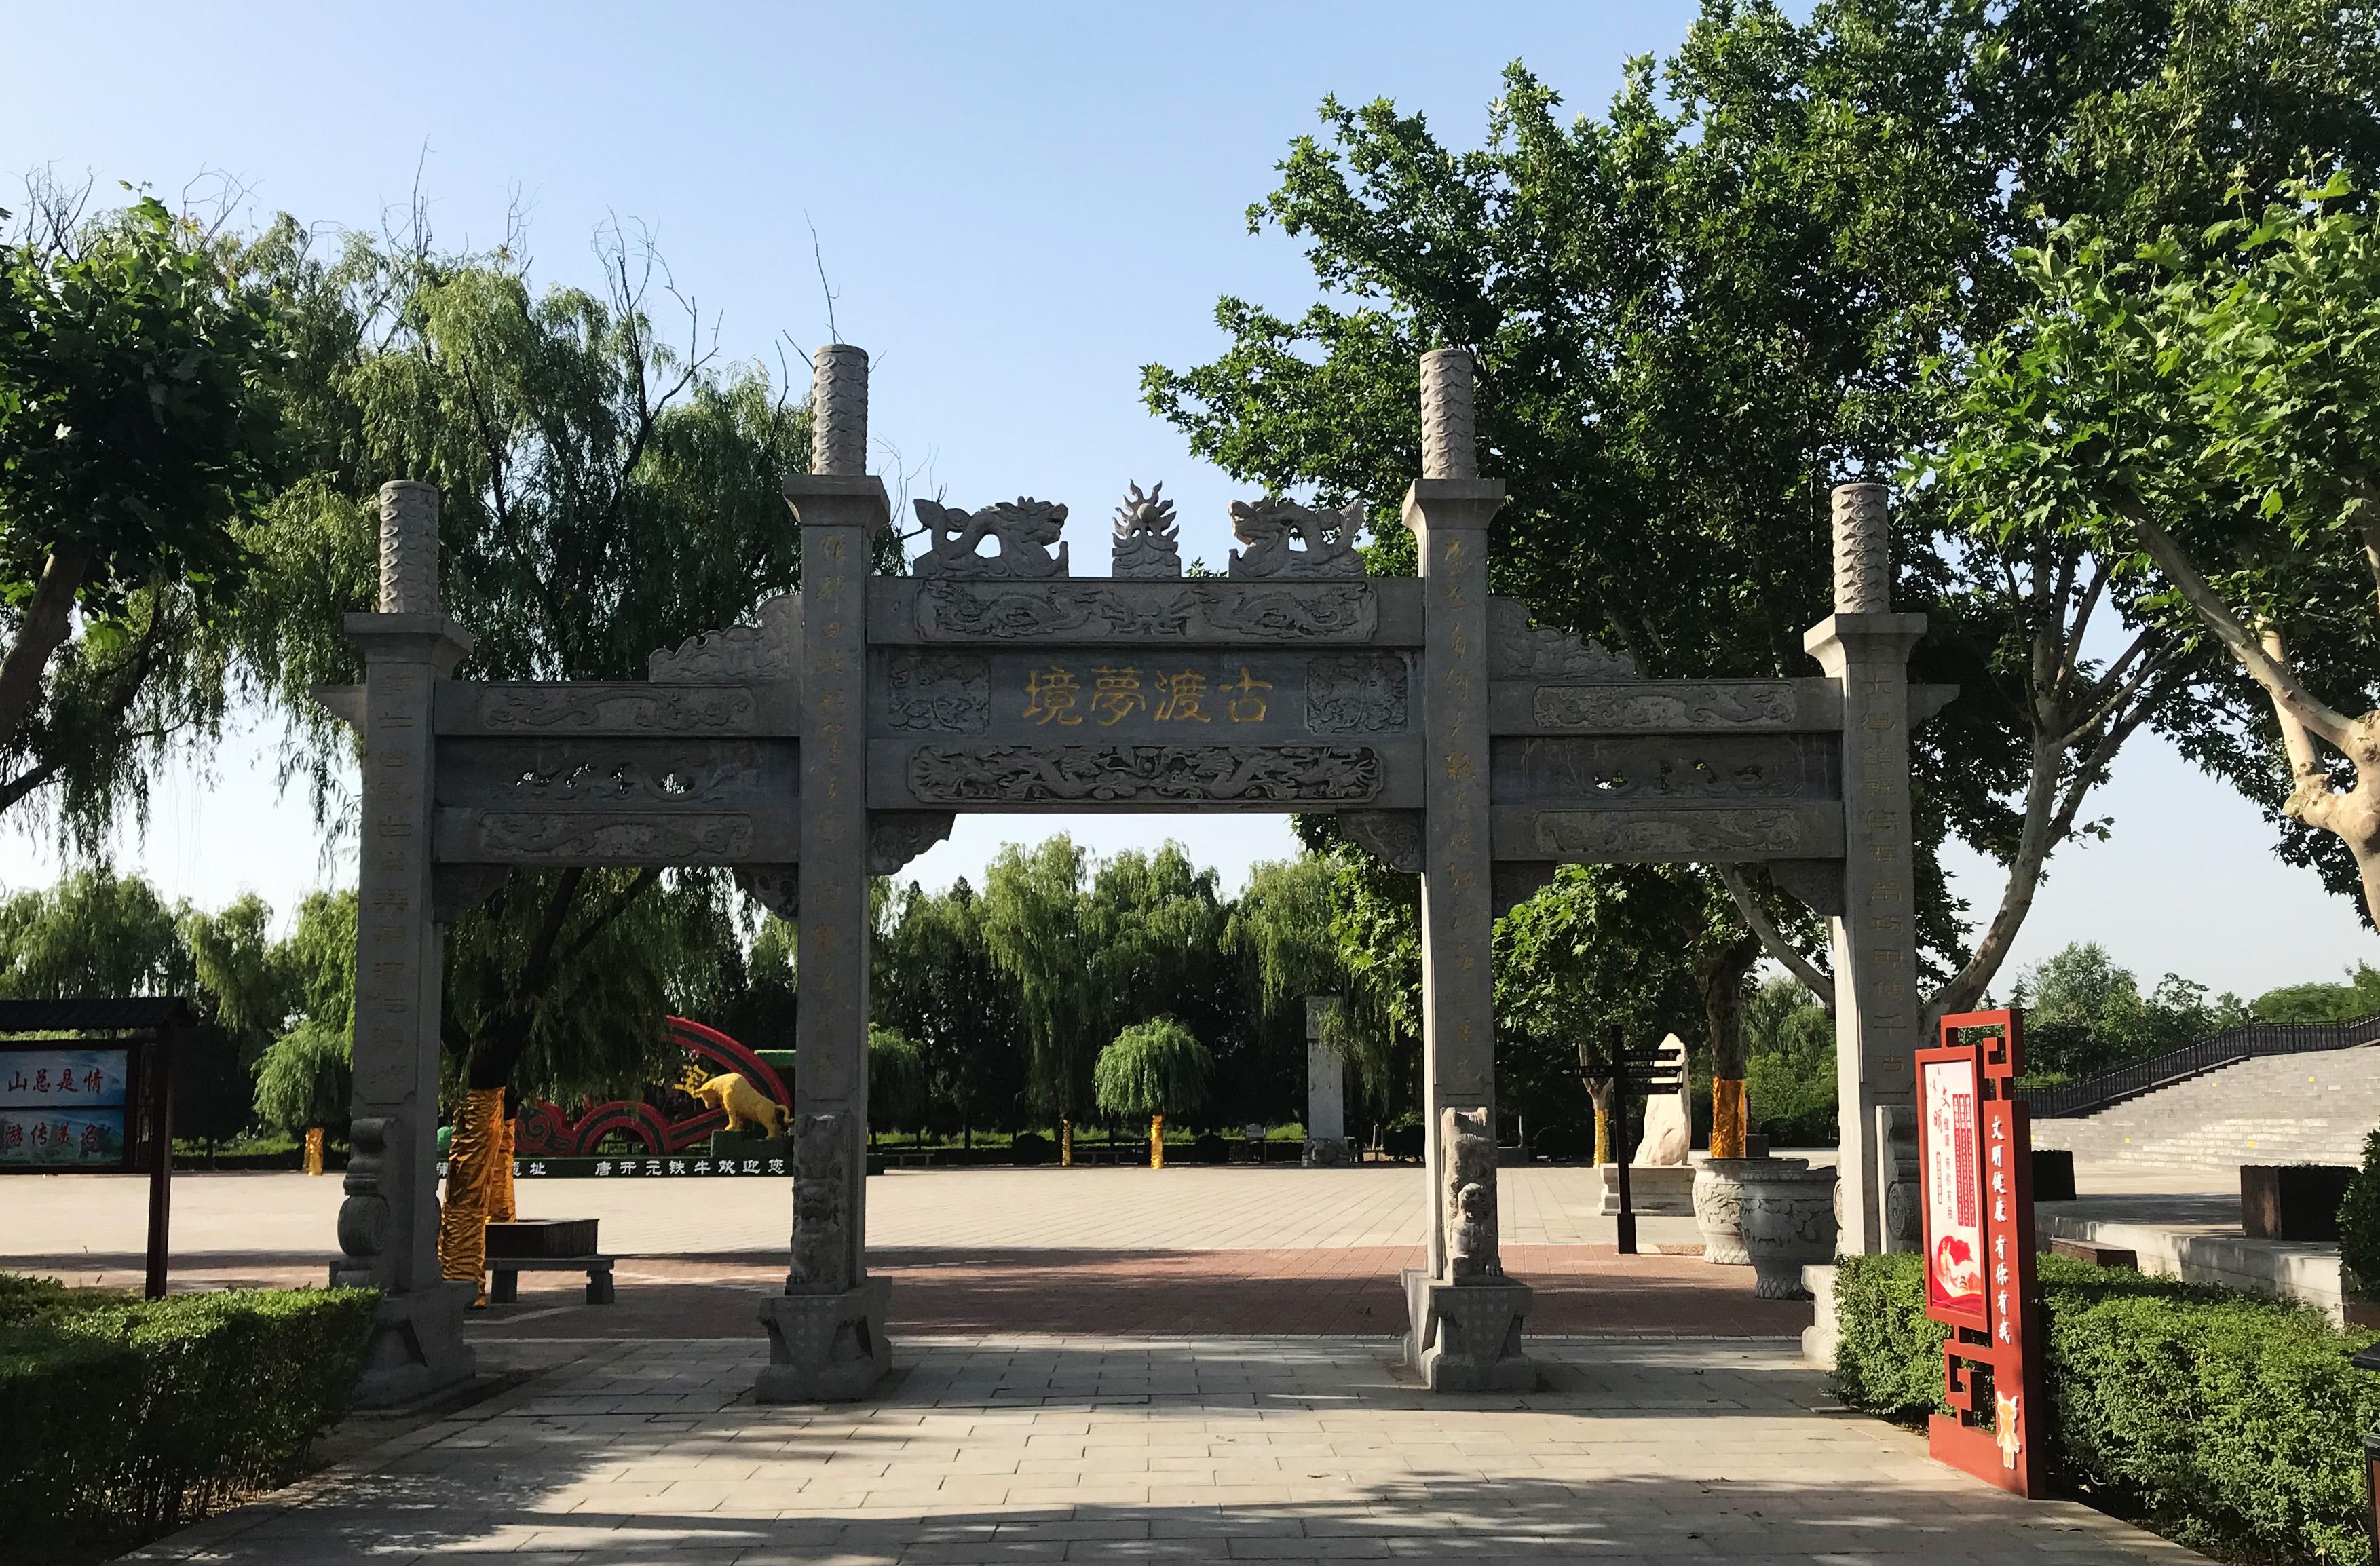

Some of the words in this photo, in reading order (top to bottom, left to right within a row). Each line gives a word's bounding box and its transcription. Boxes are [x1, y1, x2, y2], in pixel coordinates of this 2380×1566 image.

[8, 1067, 104, 1094] 山总是情
[5, 1122, 98, 1149] 游传美名
[594, 1158, 785, 1176] 唐开元铁牛欢迎您
[1990, 1115, 2008, 1223] 文明健康
[1995, 1234, 2012, 1345] 有你有我
